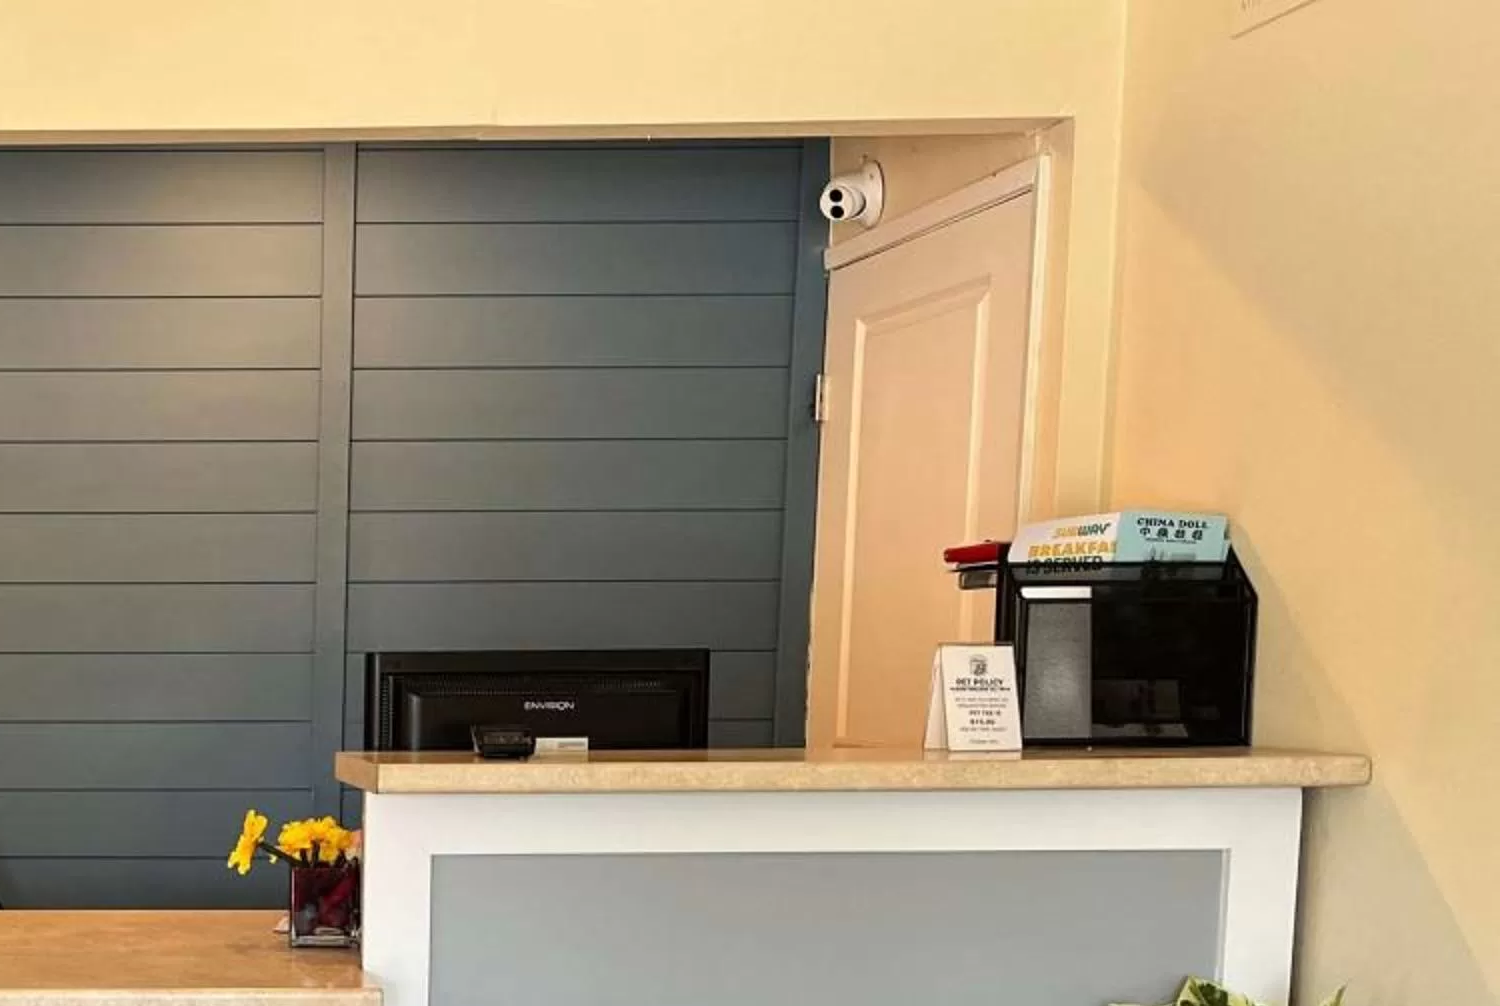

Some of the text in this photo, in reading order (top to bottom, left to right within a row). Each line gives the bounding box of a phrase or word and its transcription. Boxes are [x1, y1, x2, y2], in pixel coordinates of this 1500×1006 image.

[1137, 517, 1208, 529] CHINA DOLL
[1054, 523, 1112, 538] SUBWAY
[524, 701, 575, 711] ENVISION
